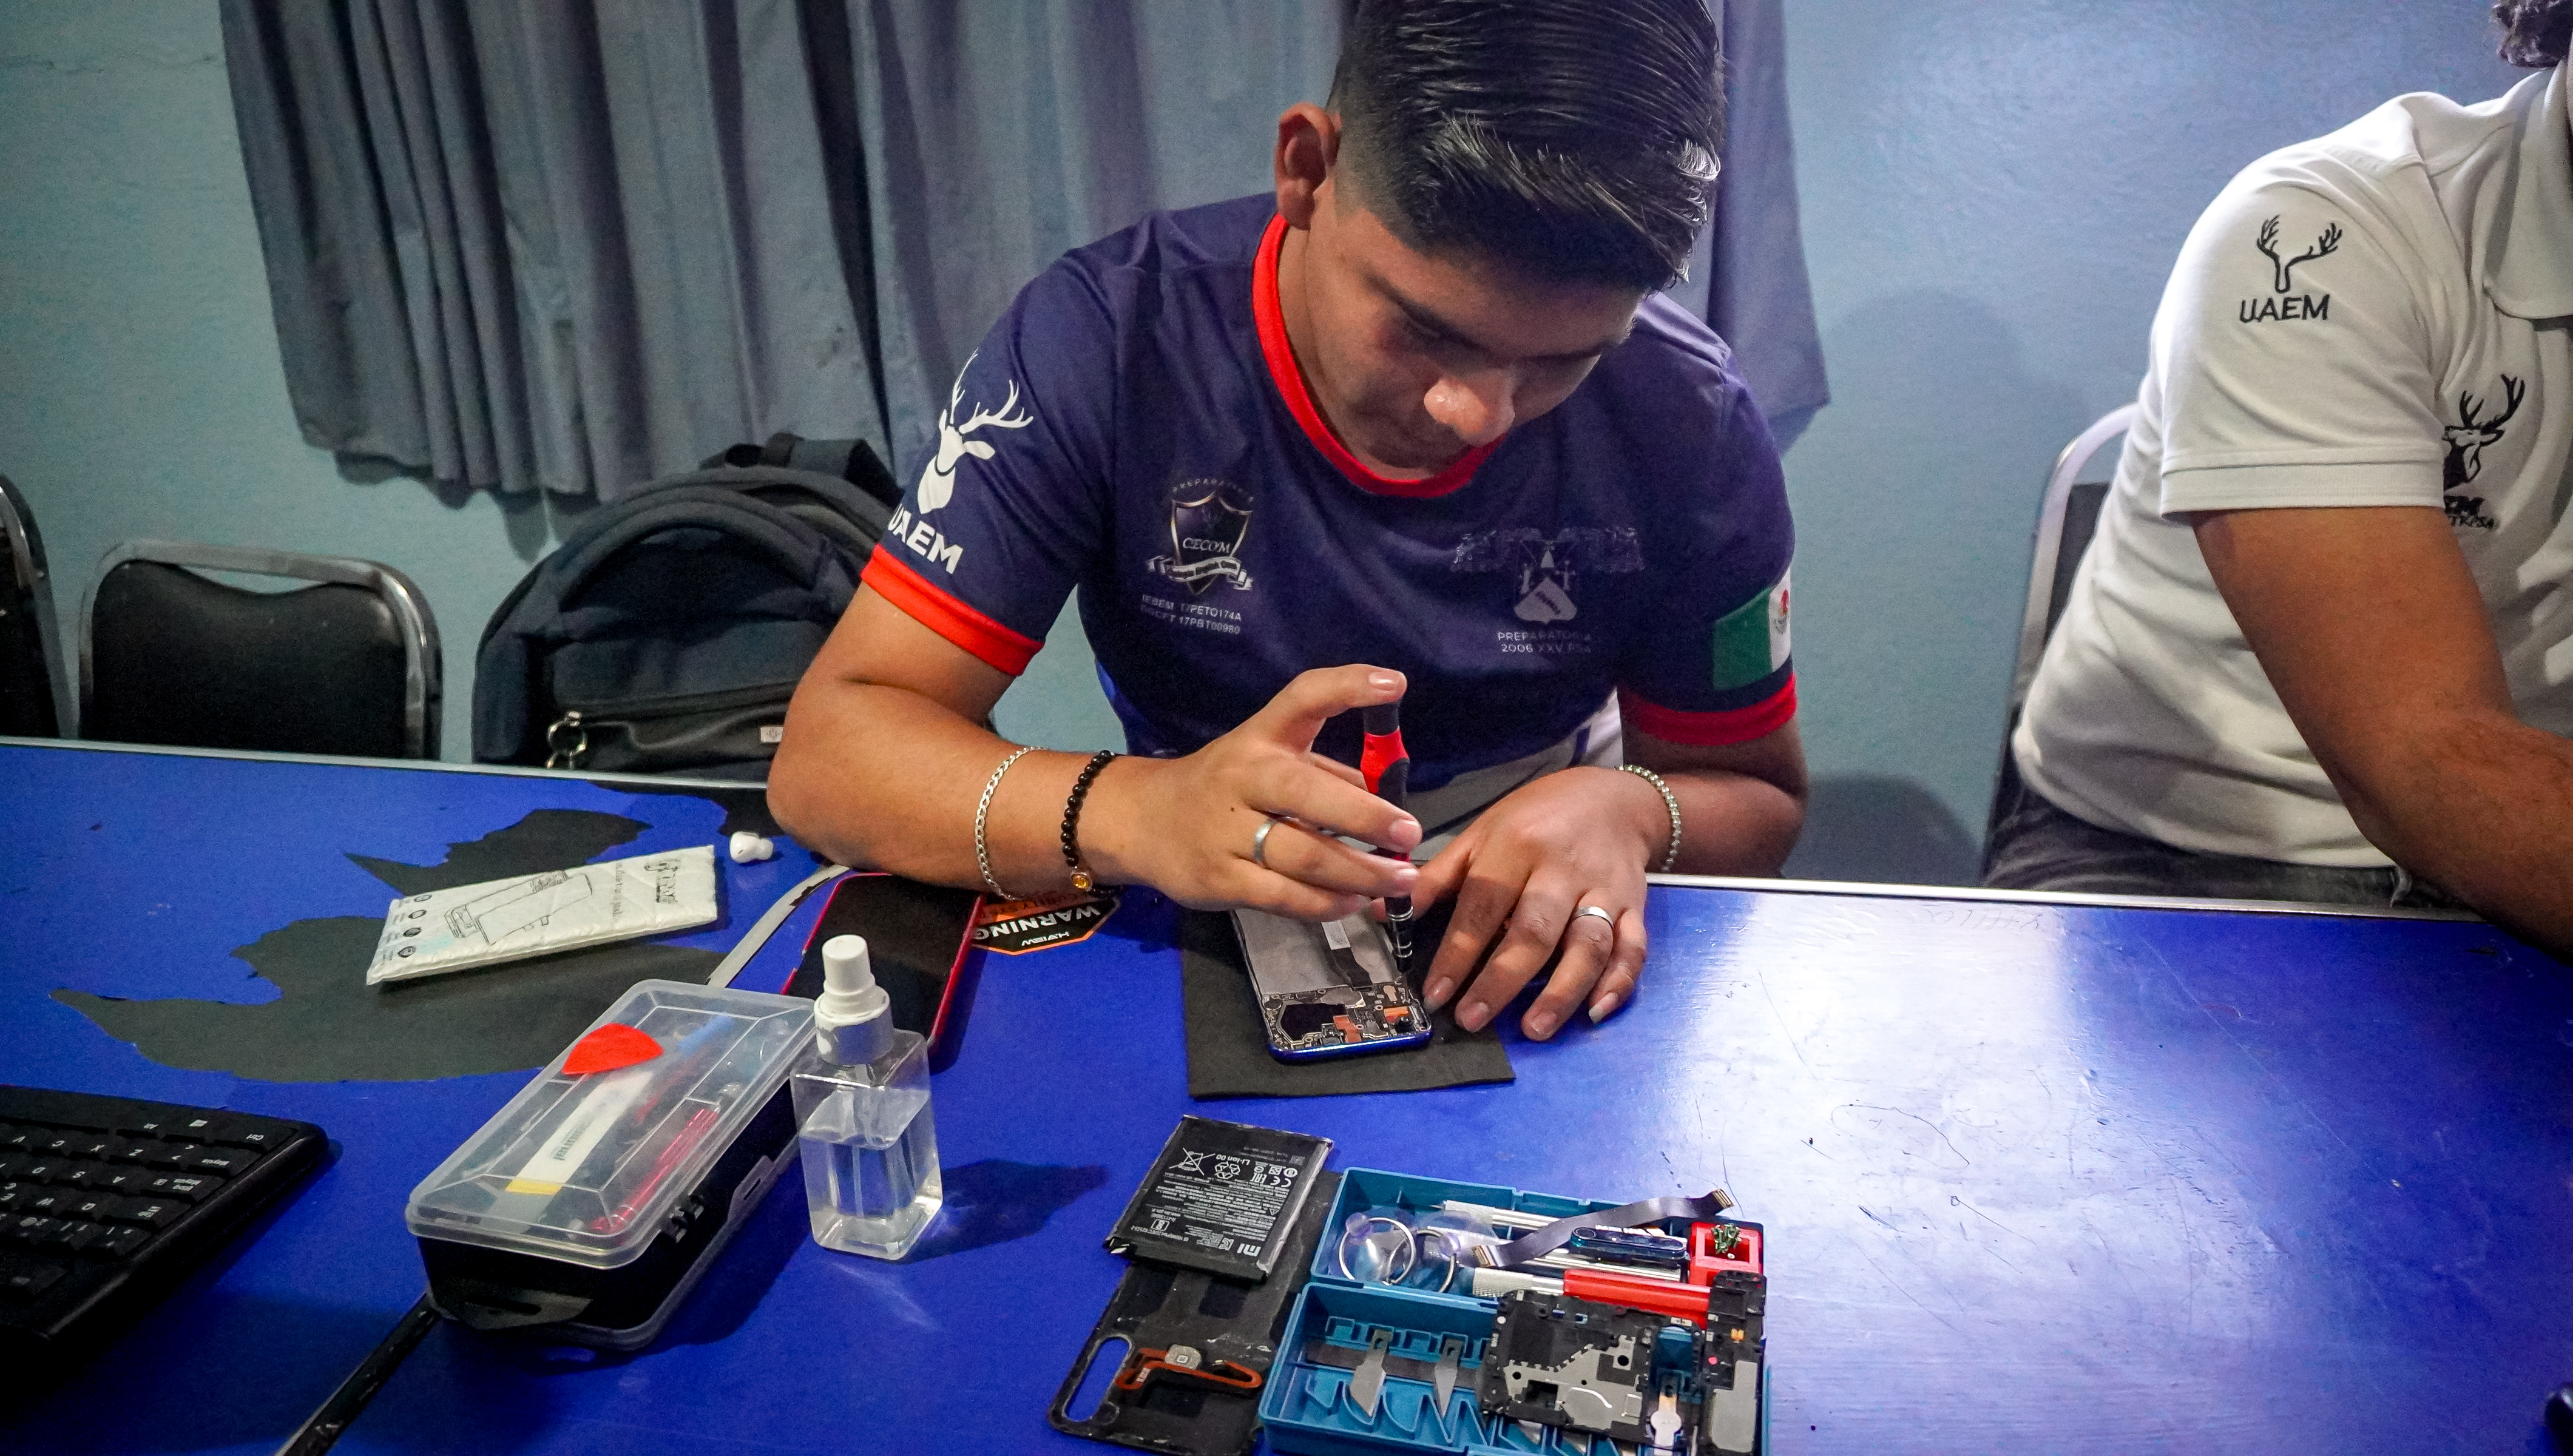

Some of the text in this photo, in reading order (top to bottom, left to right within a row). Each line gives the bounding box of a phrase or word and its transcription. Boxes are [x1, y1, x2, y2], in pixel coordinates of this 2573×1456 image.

[2239, 294, 2330, 323] UAEM
[887, 503, 964, 575] UAEM
[1183, 537, 1231, 553] CECOM
[1501, 643, 1533, 653] 2006
[972, 906, 1101, 940] WARNING
